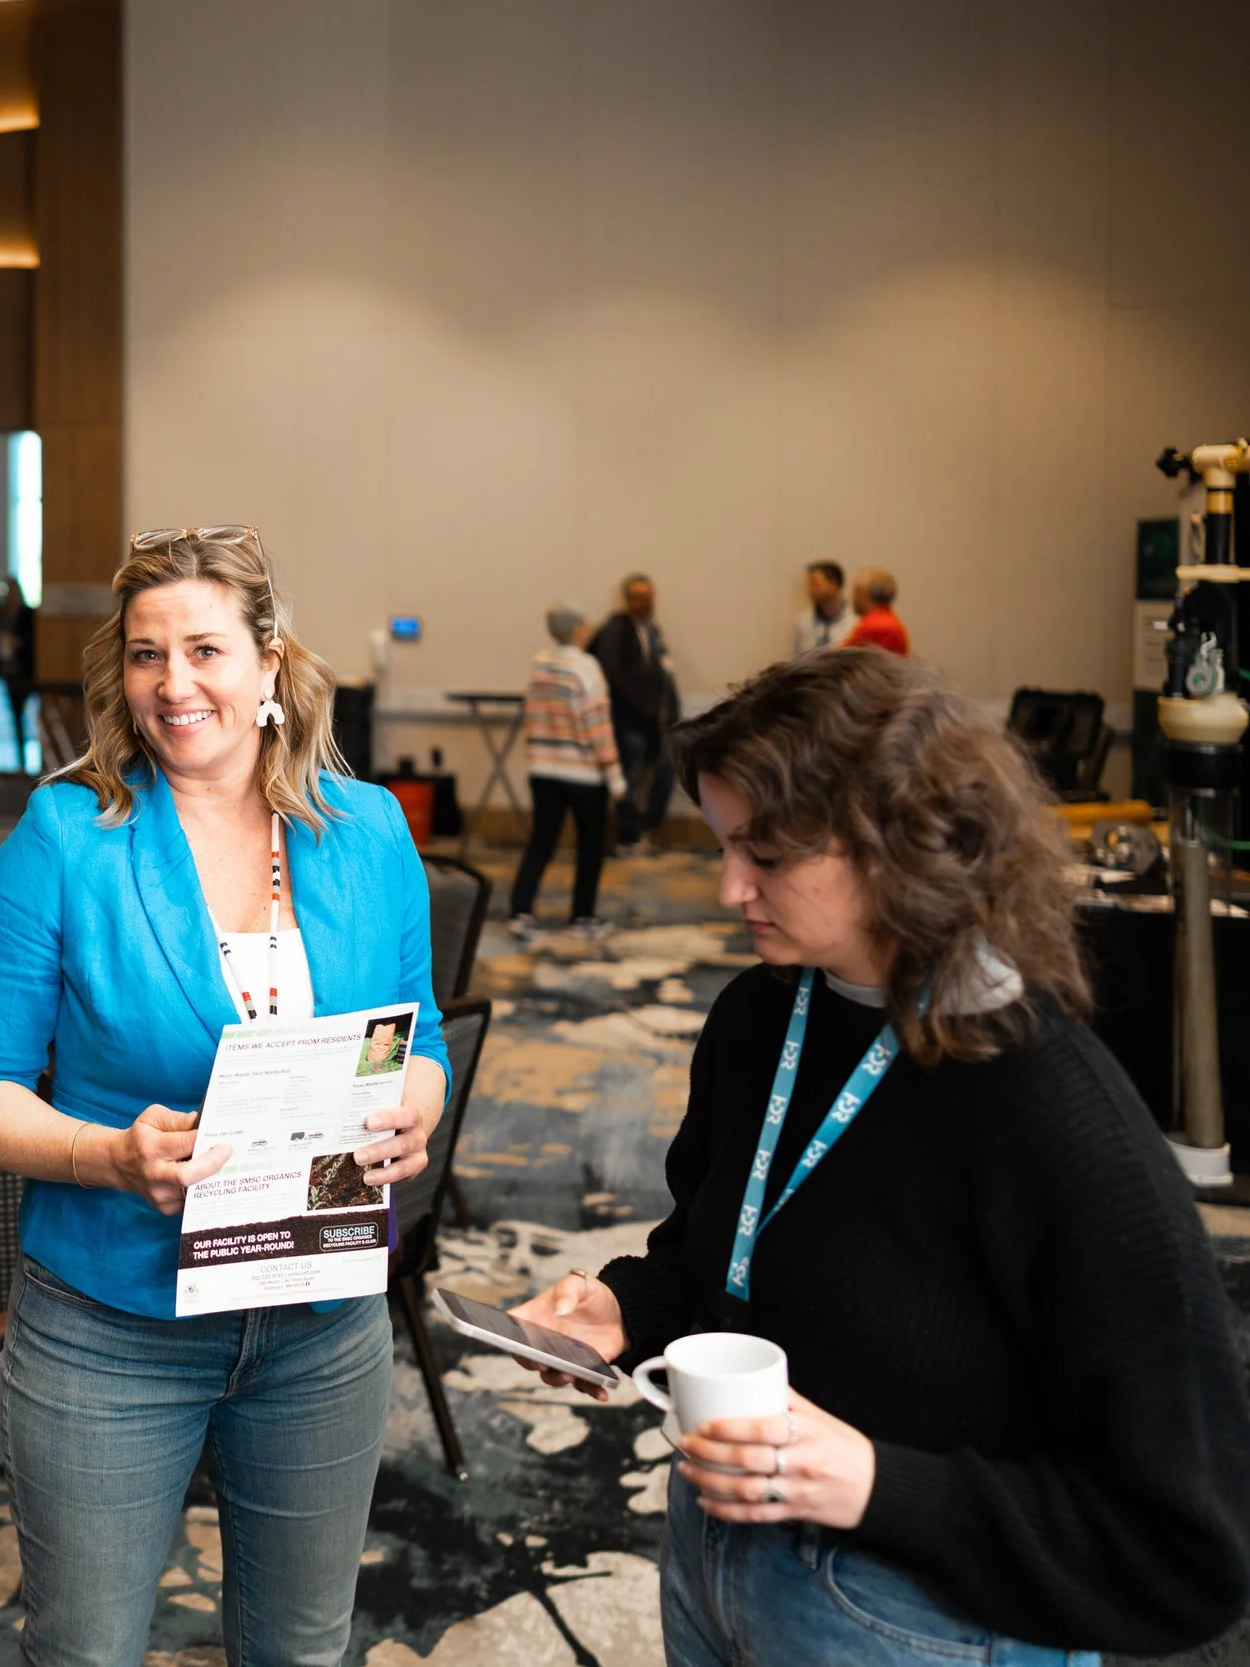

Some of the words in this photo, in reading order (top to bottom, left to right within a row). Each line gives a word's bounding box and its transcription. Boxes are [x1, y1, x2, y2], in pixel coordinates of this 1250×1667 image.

[225, 1043, 249, 1052] ITEMS
[251, 1042, 263, 1050] WE
[265, 1040, 295, 1048] ACCEPT
[297, 1037, 320, 1045] FROM
[321, 1033, 362, 1043] RESIDENTS
[195, 1180, 220, 1190] ABOUT
[223, 1178, 237, 1186] THE
[239, 1176, 261, 1185] SMSC
[262, 1171, 302, 1181] ORGANICS
[193, 1187, 237, 1199] RECYCLING
[237, 1183, 271, 1193] FACILITY
[193, 1240, 211, 1249] OUR
[213, 1235, 247, 1247] FACILITY
[248, 1234, 256, 1243] IS
[256, 1232, 278, 1242] OPEN
[279, 1230, 291, 1239] TO
[323, 1225, 375, 1239] SUBSCRIBE
[193, 1250, 209, 1260] THE
[210, 1246, 239, 1257] PUBLIC
[240, 1240, 295, 1254] YEAR-ROUND!
[260, 1262, 298, 1273] CONTACT
[301, 1260, 312, 1269] US
